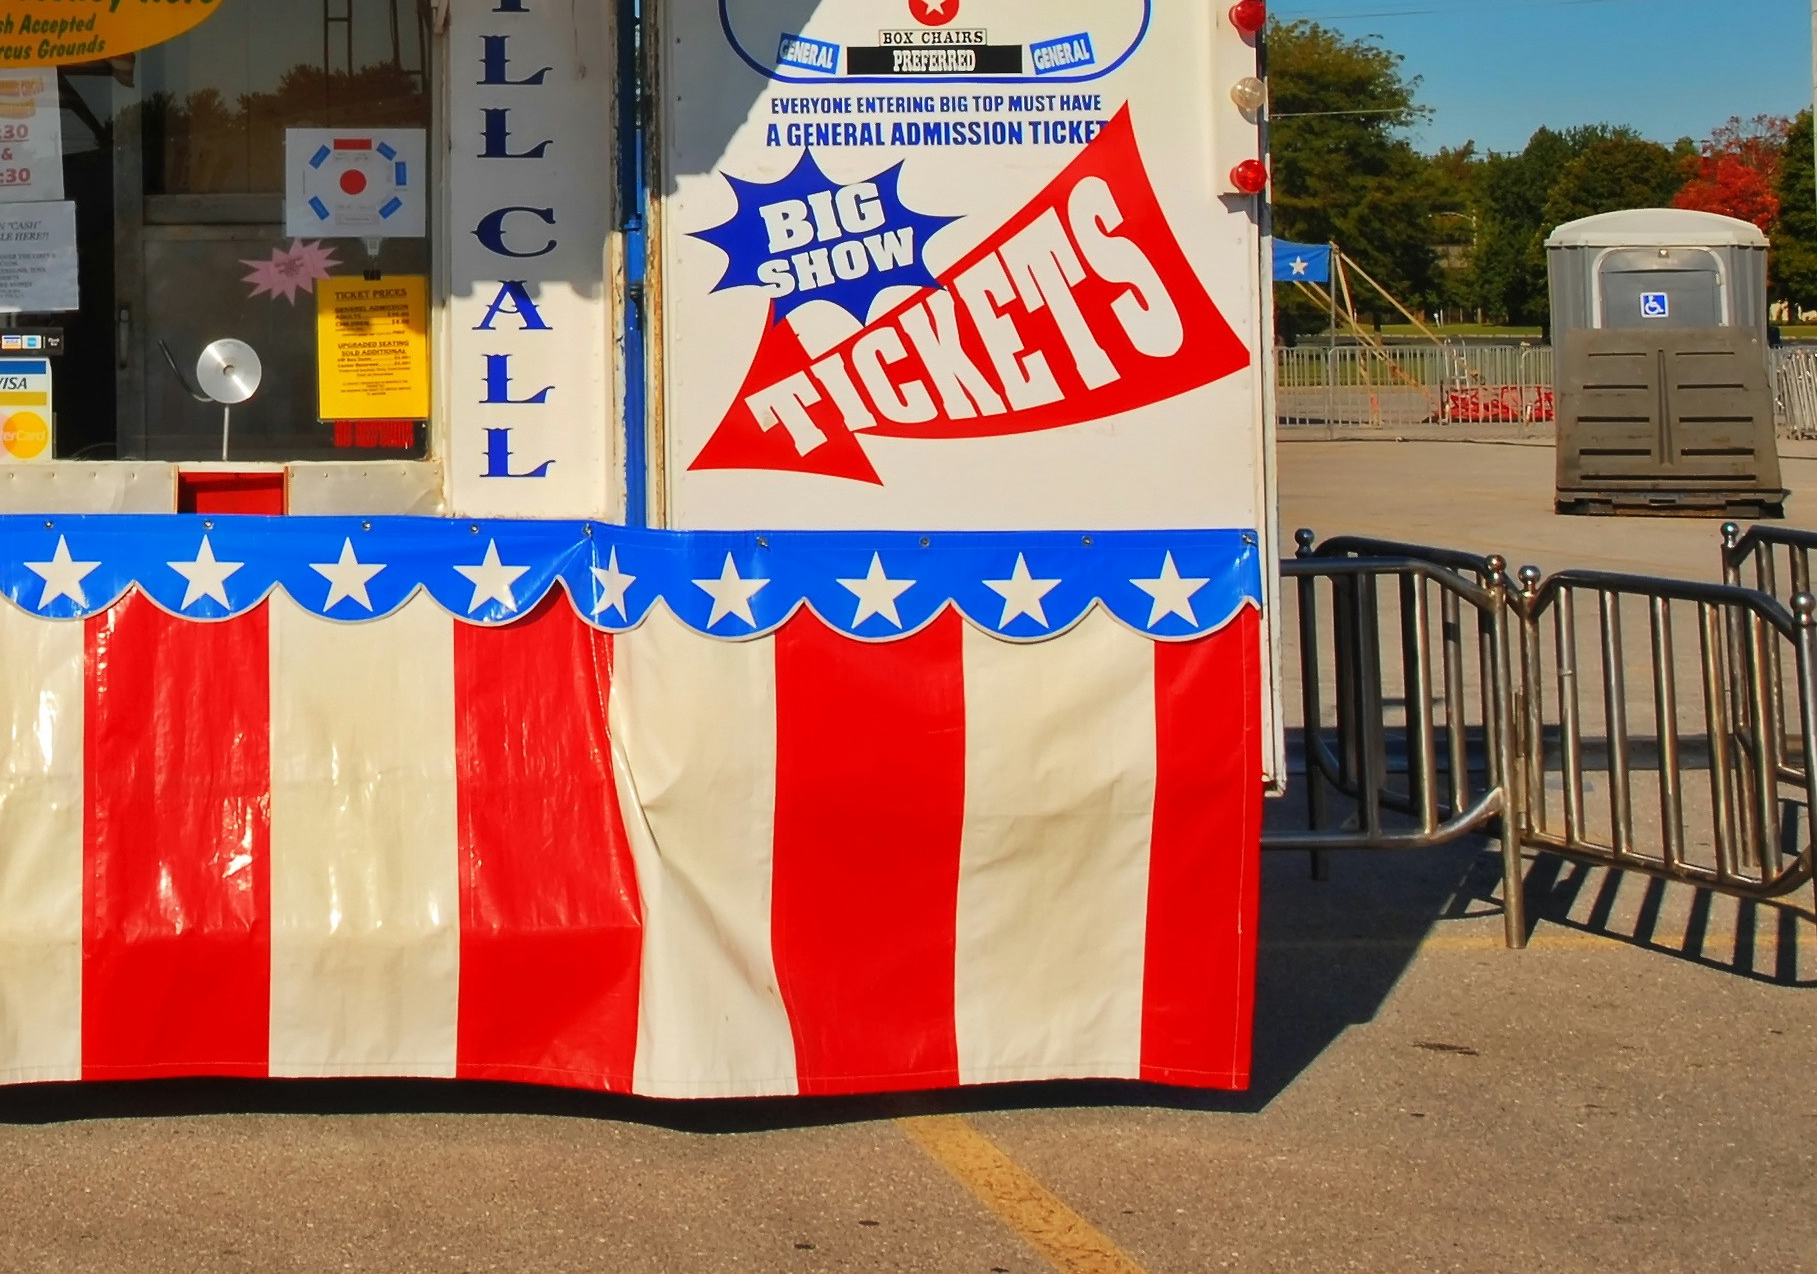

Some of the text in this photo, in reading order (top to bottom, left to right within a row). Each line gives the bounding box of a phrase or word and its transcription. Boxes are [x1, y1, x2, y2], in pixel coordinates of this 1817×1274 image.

[19, 13, 96, 36] Accepted
[882, 30, 984, 44] BOX CHAIRS
[37, 35, 105, 58] Grounds
[780, 38, 834, 69] GENERAL
[1033, 38, 1090, 69] GENERAL
[892, 49, 976, 72] PREFERRED
[770, 93, 1102, 114] EVERYONE ENTERING BIG TOP MUST HAVE
[766, 122, 782, 147] A
[786, 122, 885, 146] GENERAL
[890, 120, 1023, 146] ADMISSION
[1, 148, 13, 161] &
[759, 181, 885, 255] BIG
[756, 227, 914, 299] SHOW
[335, 287, 407, 301] TICKET PRICES
[744, 175, 1184, 457] TICKETS
[471, 206, 558, 478] CALL
